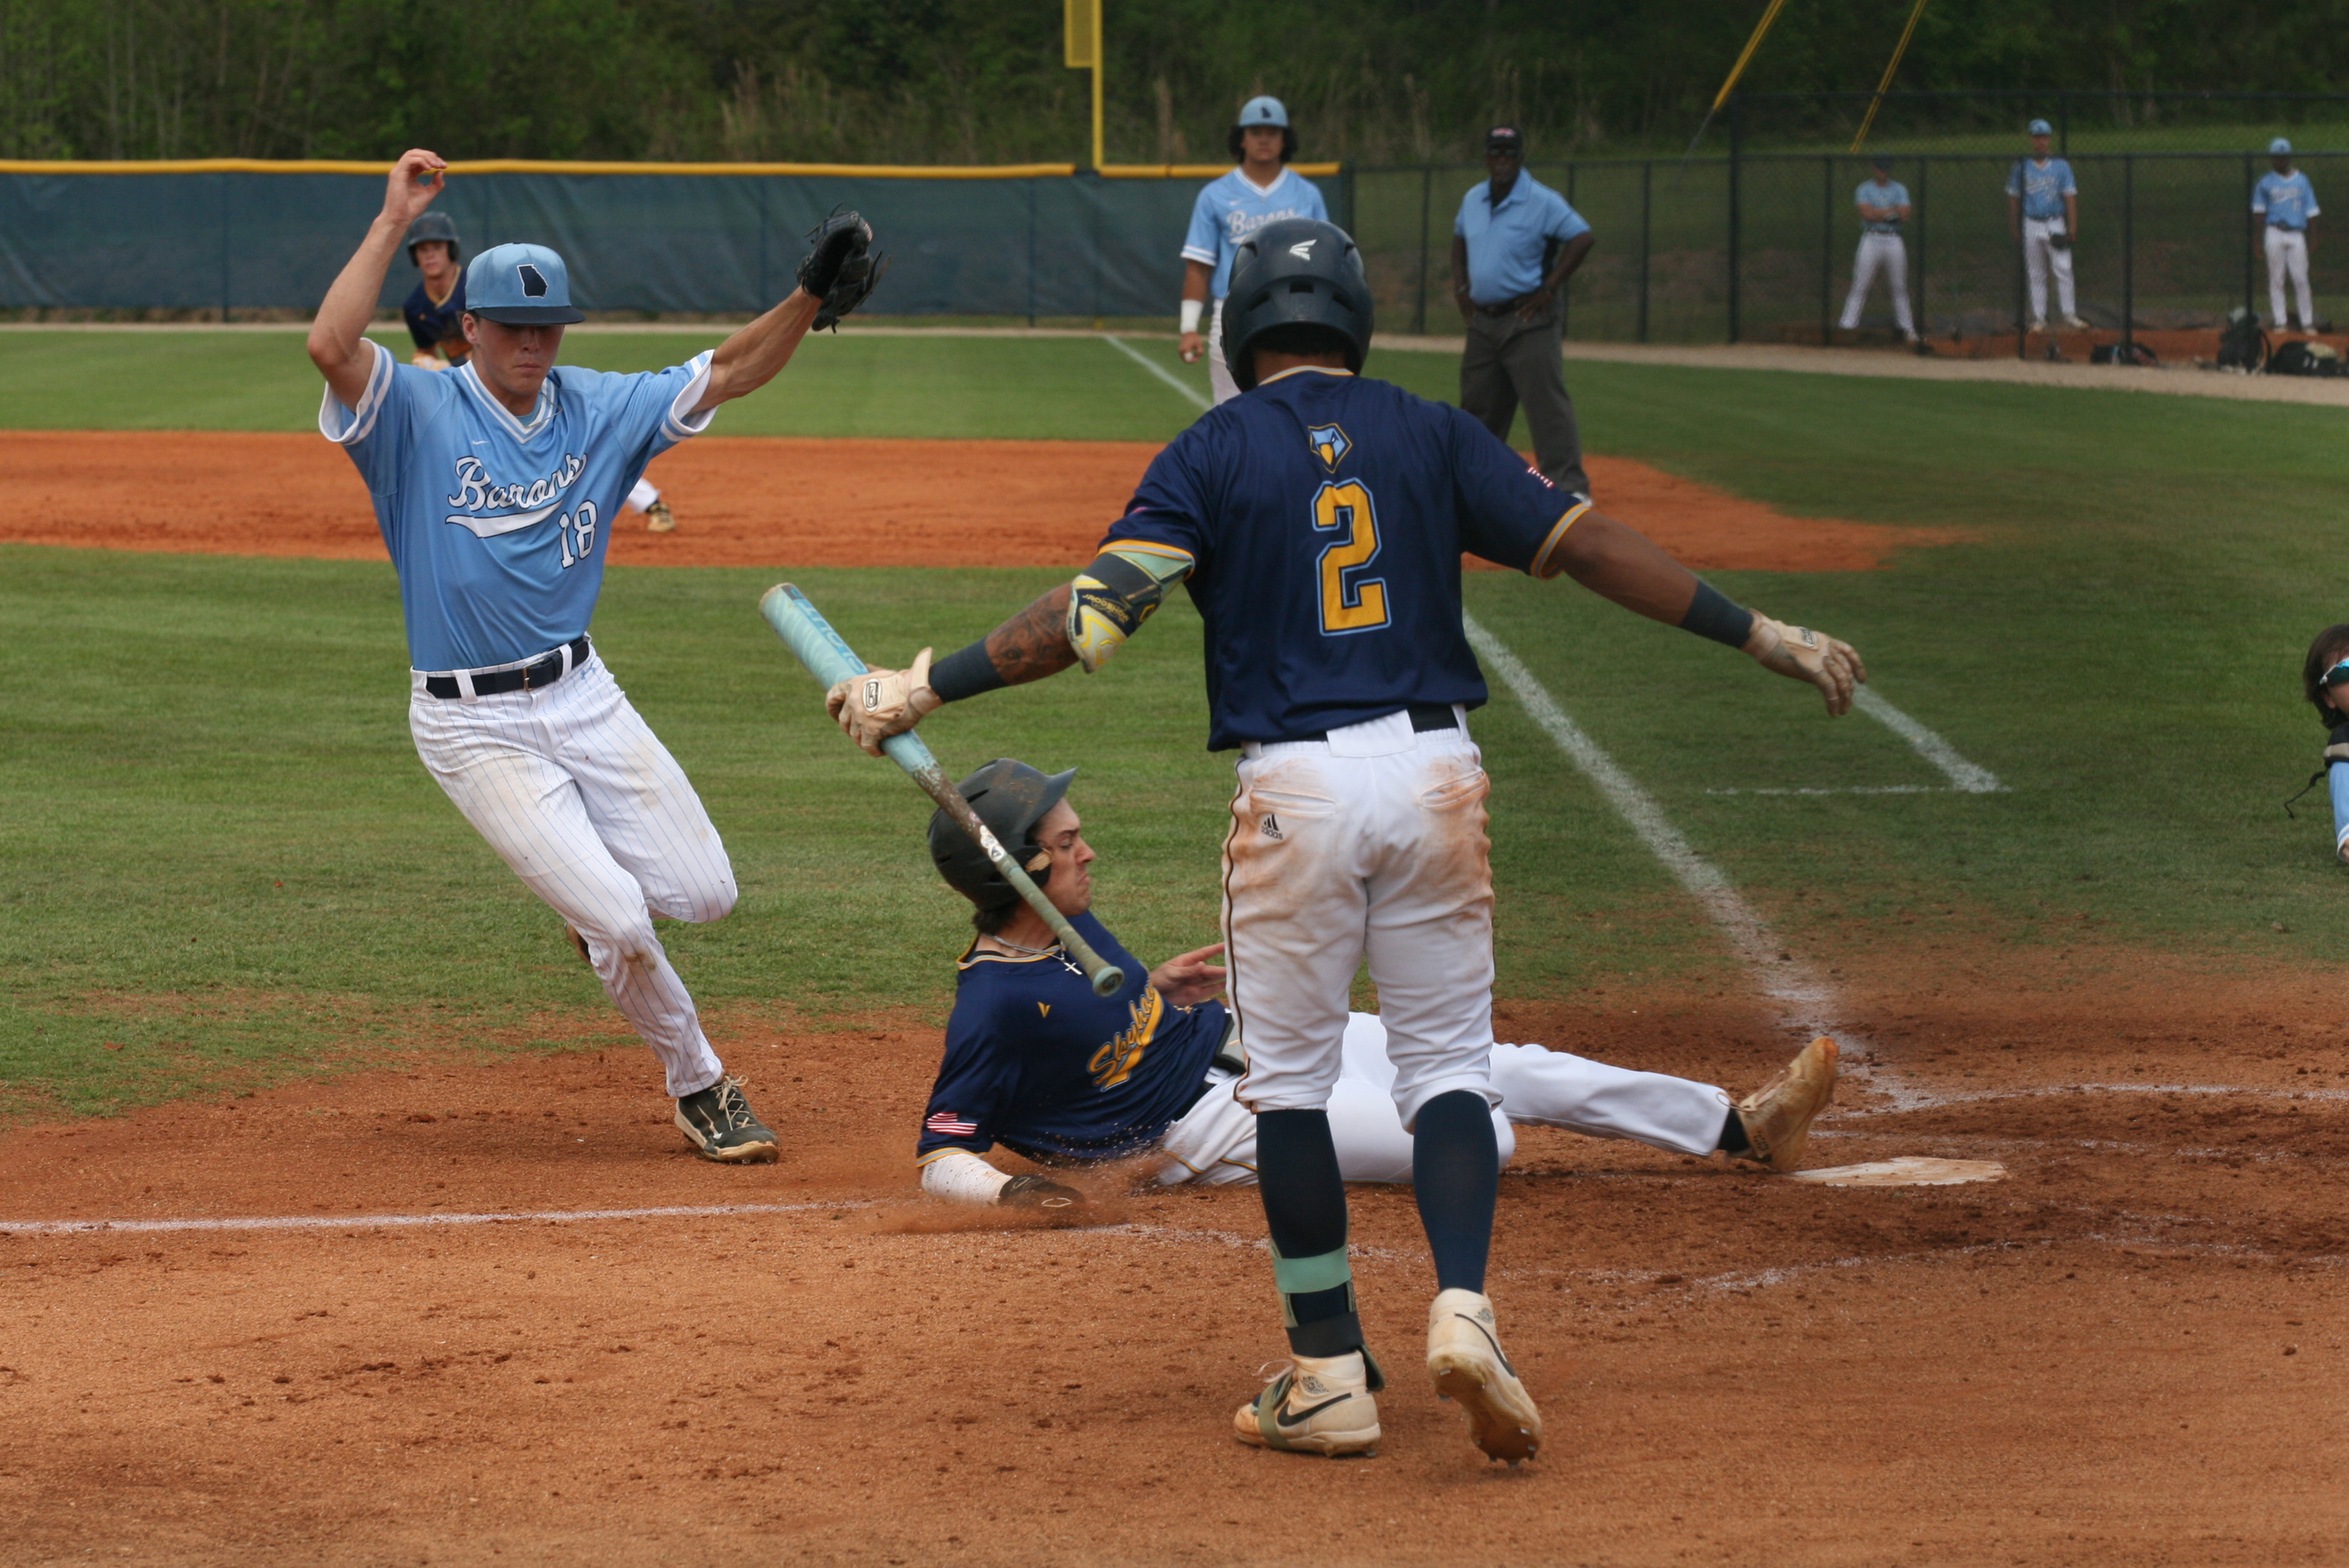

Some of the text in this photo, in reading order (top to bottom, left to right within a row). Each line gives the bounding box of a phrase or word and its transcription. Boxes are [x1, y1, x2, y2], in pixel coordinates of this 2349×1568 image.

[448, 453, 589, 511] Barons
[559, 500, 598, 569] 18
[1311, 477, 1392, 637] 2
